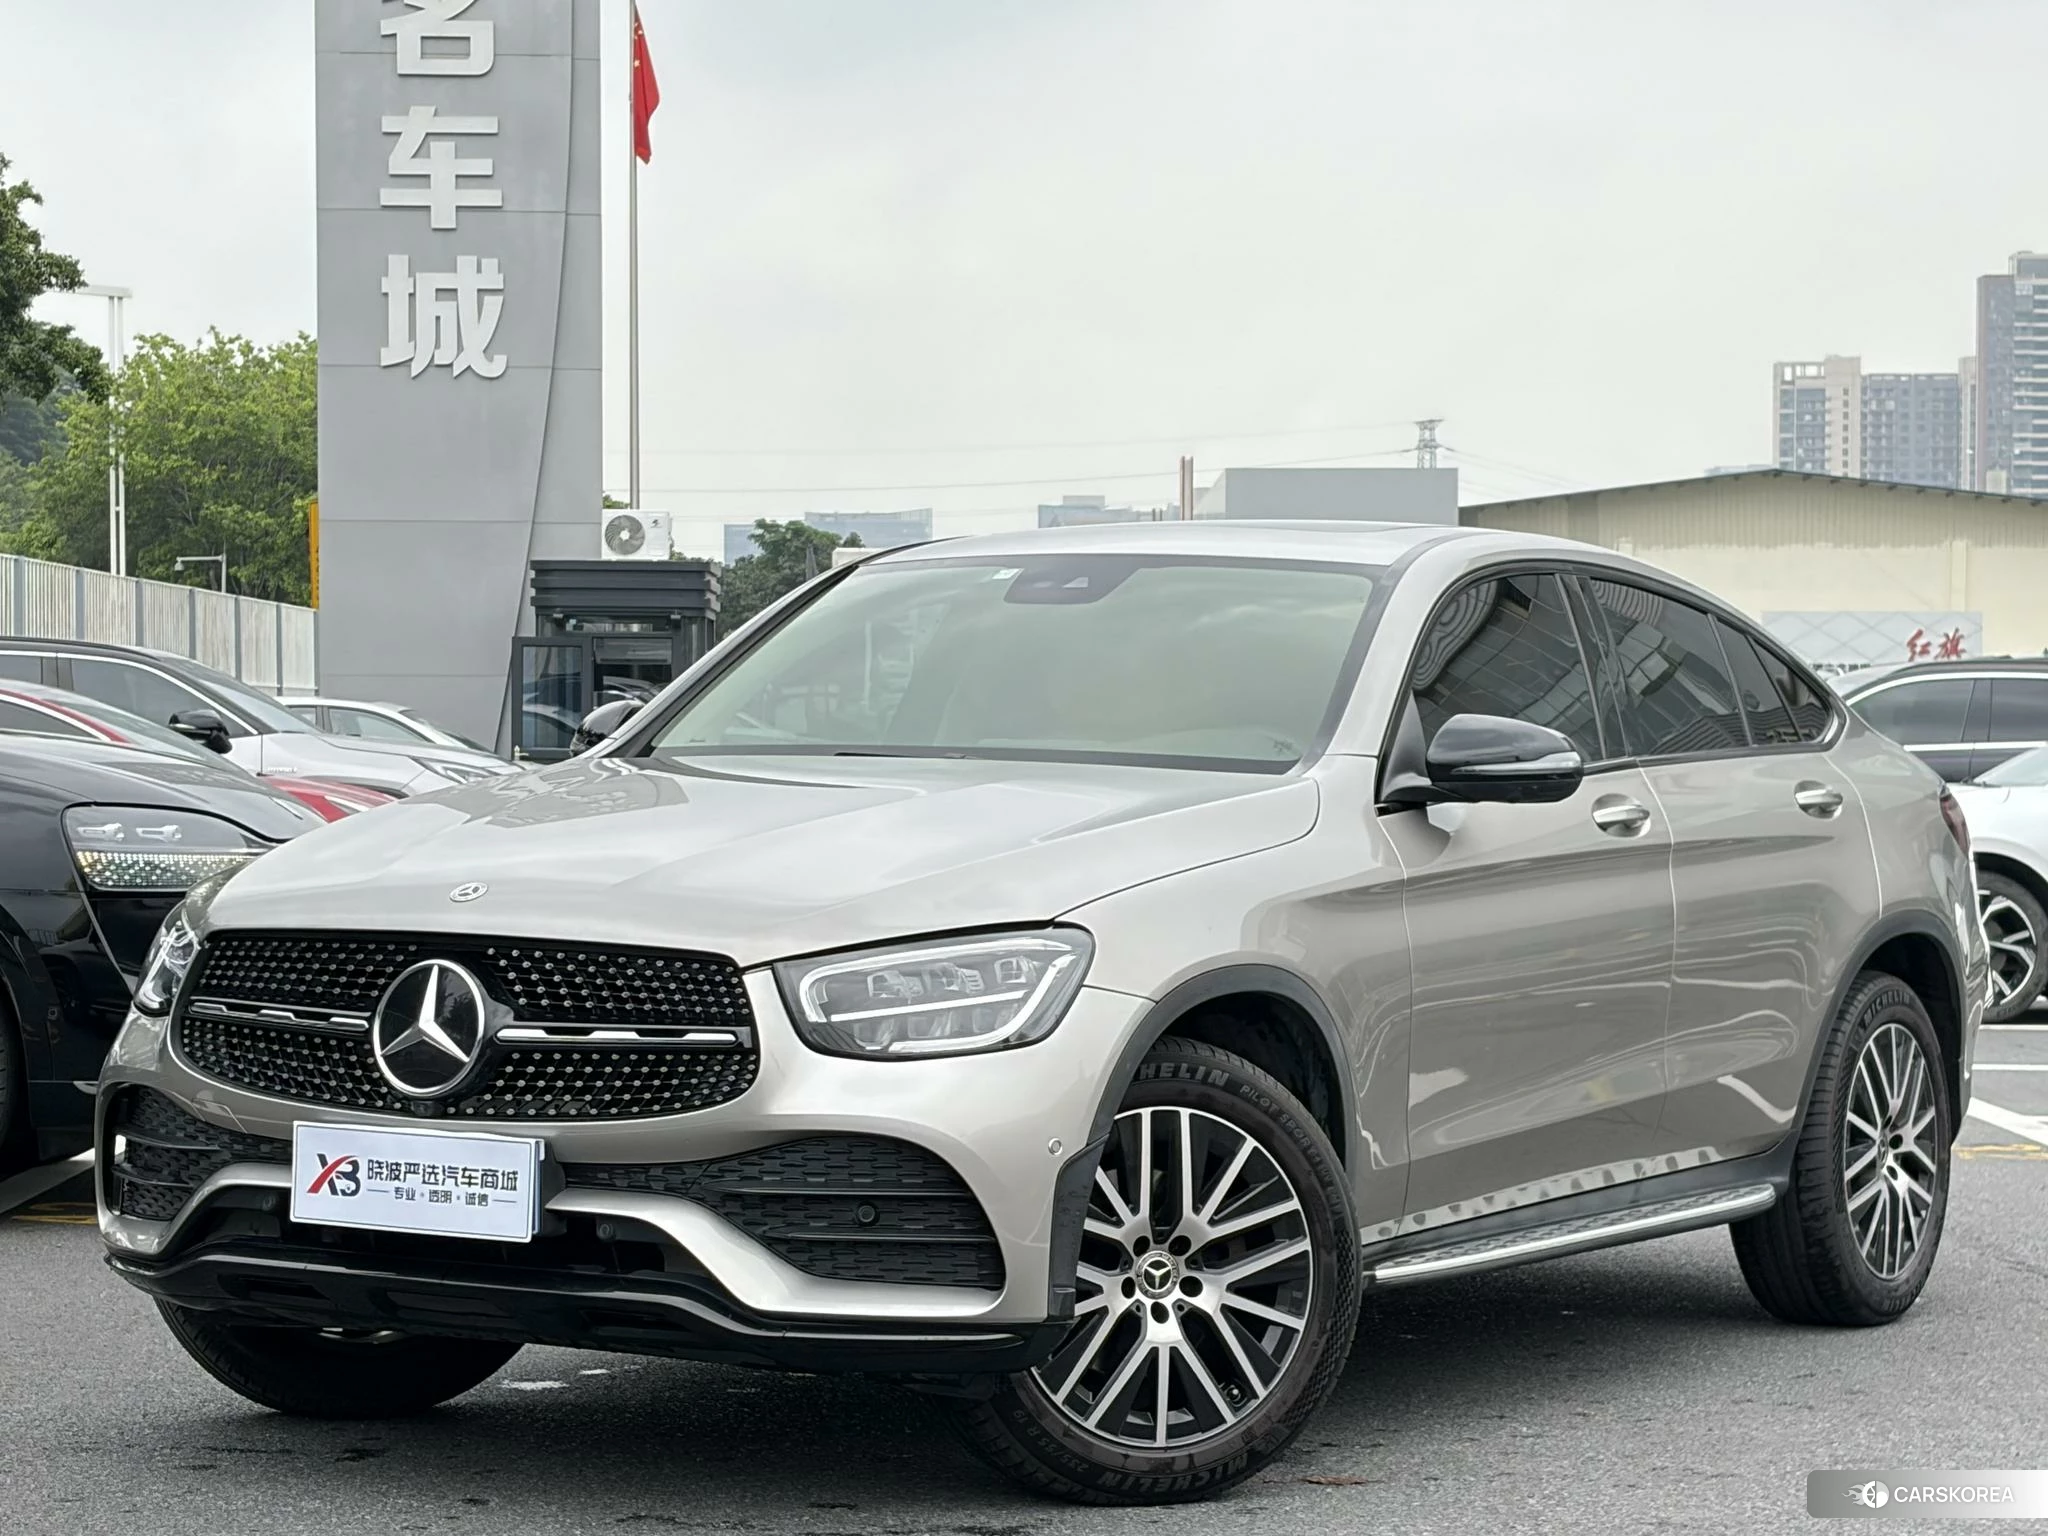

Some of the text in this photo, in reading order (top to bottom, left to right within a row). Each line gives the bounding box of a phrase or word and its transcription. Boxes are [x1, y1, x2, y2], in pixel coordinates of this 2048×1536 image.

[380, 0, 507, 379] 名车城
[1906, 627, 1967, 662] 红旗
[1863, 989, 1910, 1026] MICHELIN
[1139, 1062, 1230, 1087] HELIN
[1239, 1083, 1279, 1114] PILOT
[367, 1158, 519, 1192] 晓波严选汽车商城
[1098, 1453, 1248, 1491] MICHELIN
